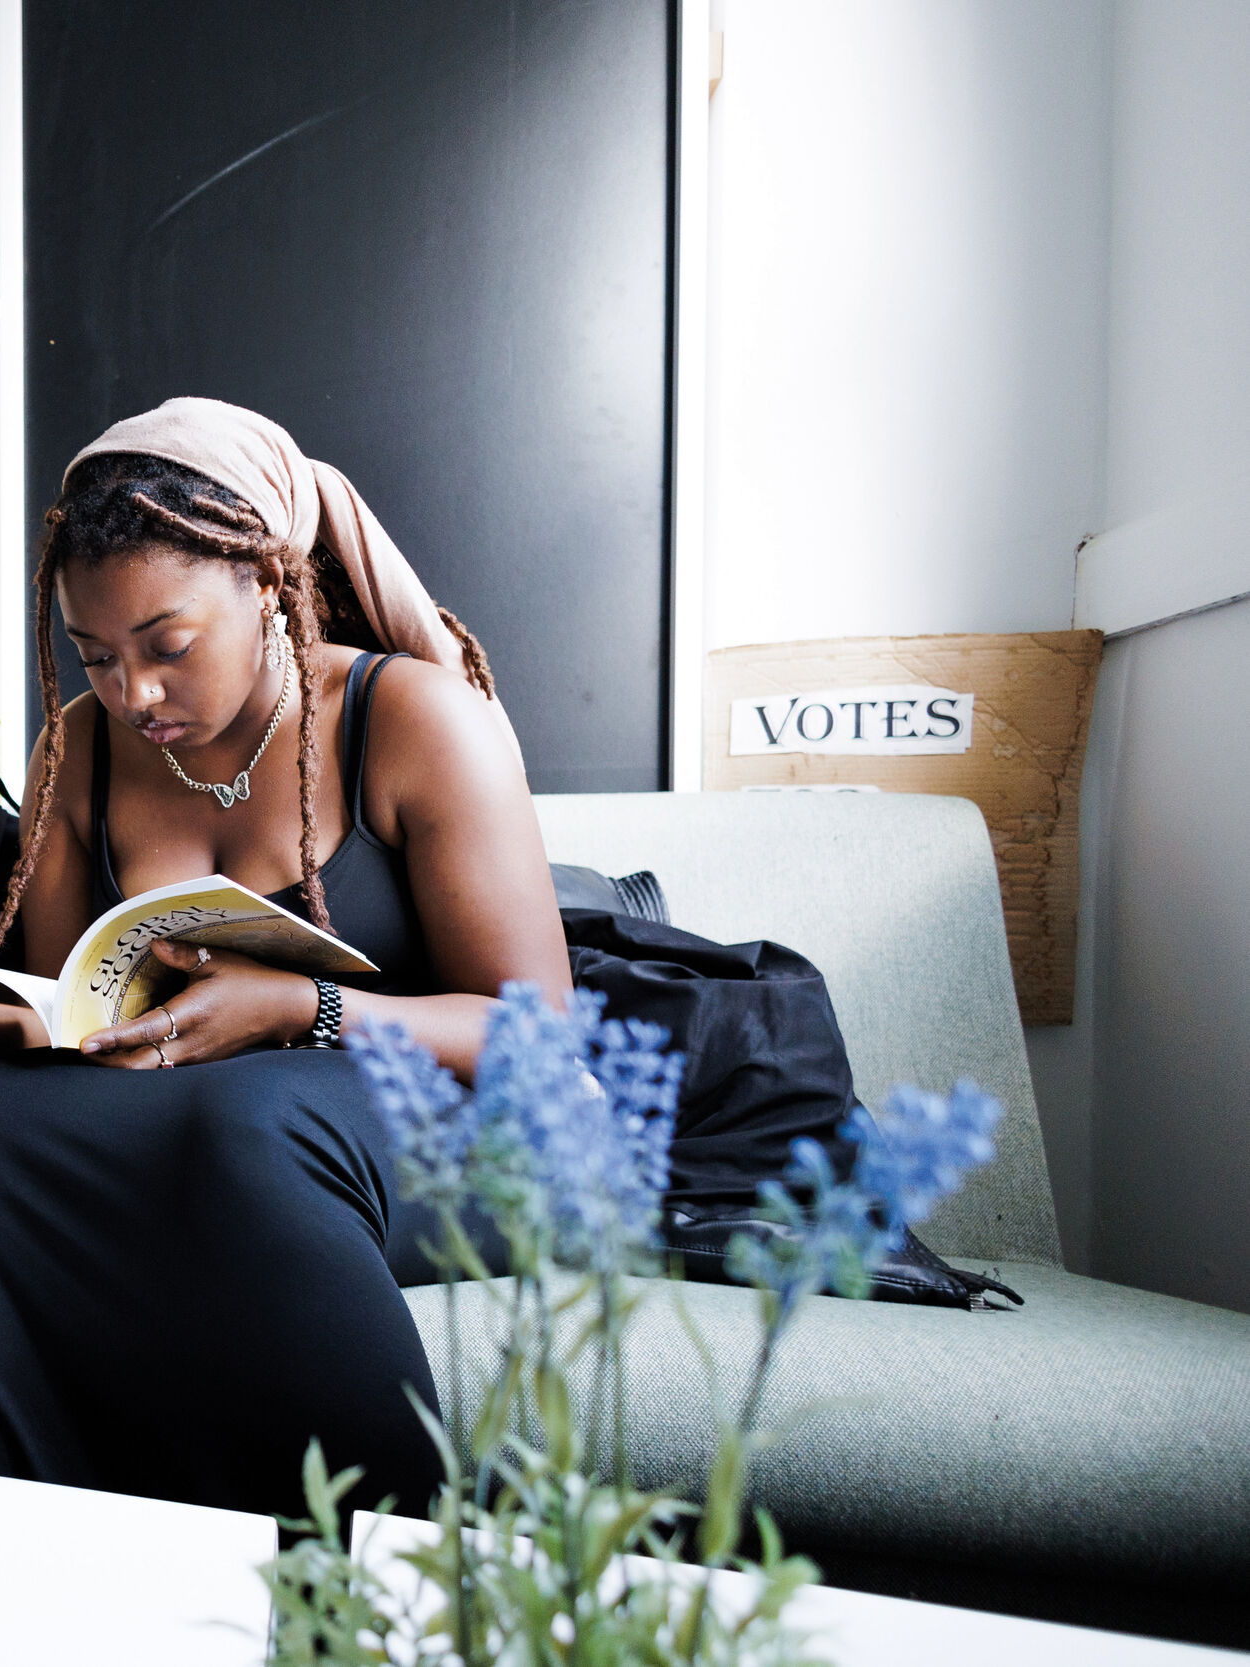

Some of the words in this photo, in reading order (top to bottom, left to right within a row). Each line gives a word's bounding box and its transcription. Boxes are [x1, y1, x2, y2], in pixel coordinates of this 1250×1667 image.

[754, 697, 962, 745] VOTES
[90, 906, 207, 992] GLOBAL
[102, 908, 227, 999] SOCIETY
[112, 996, 123, 1026] ournal
